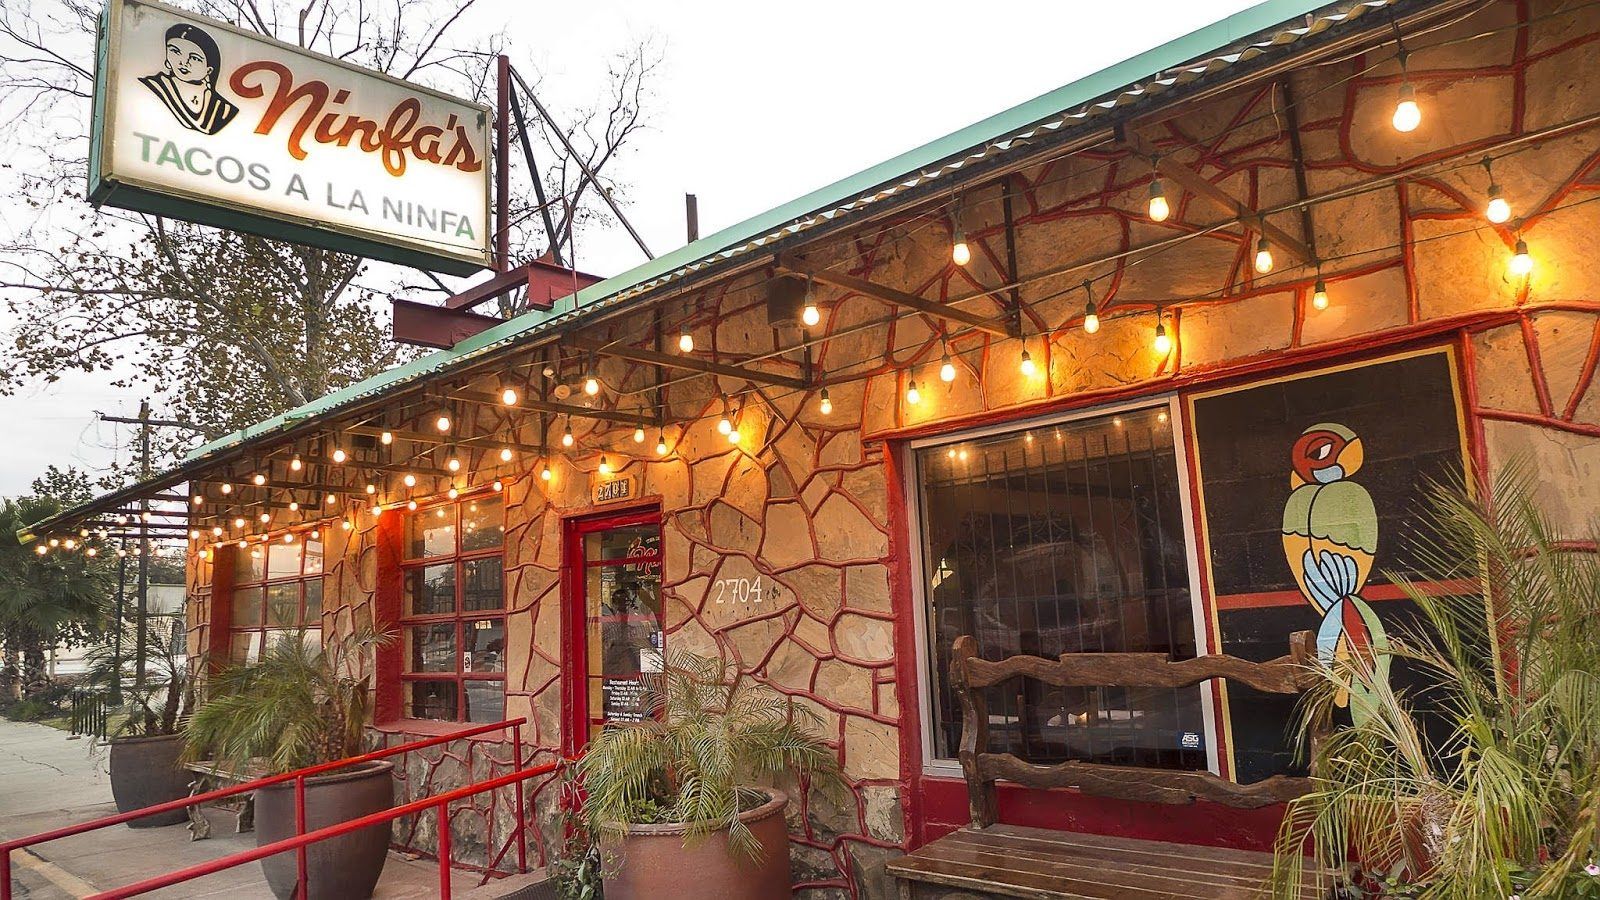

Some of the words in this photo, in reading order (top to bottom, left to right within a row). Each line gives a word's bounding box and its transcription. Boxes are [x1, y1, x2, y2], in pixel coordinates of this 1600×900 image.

[229, 61, 482, 177] Ninfa's
[133, 131, 271, 191] TACOS
[285, 173, 309, 201] A
[327, 182, 370, 215] LA
[382, 196, 475, 241] NINFA
[715, 576, 763, 604] 2704
